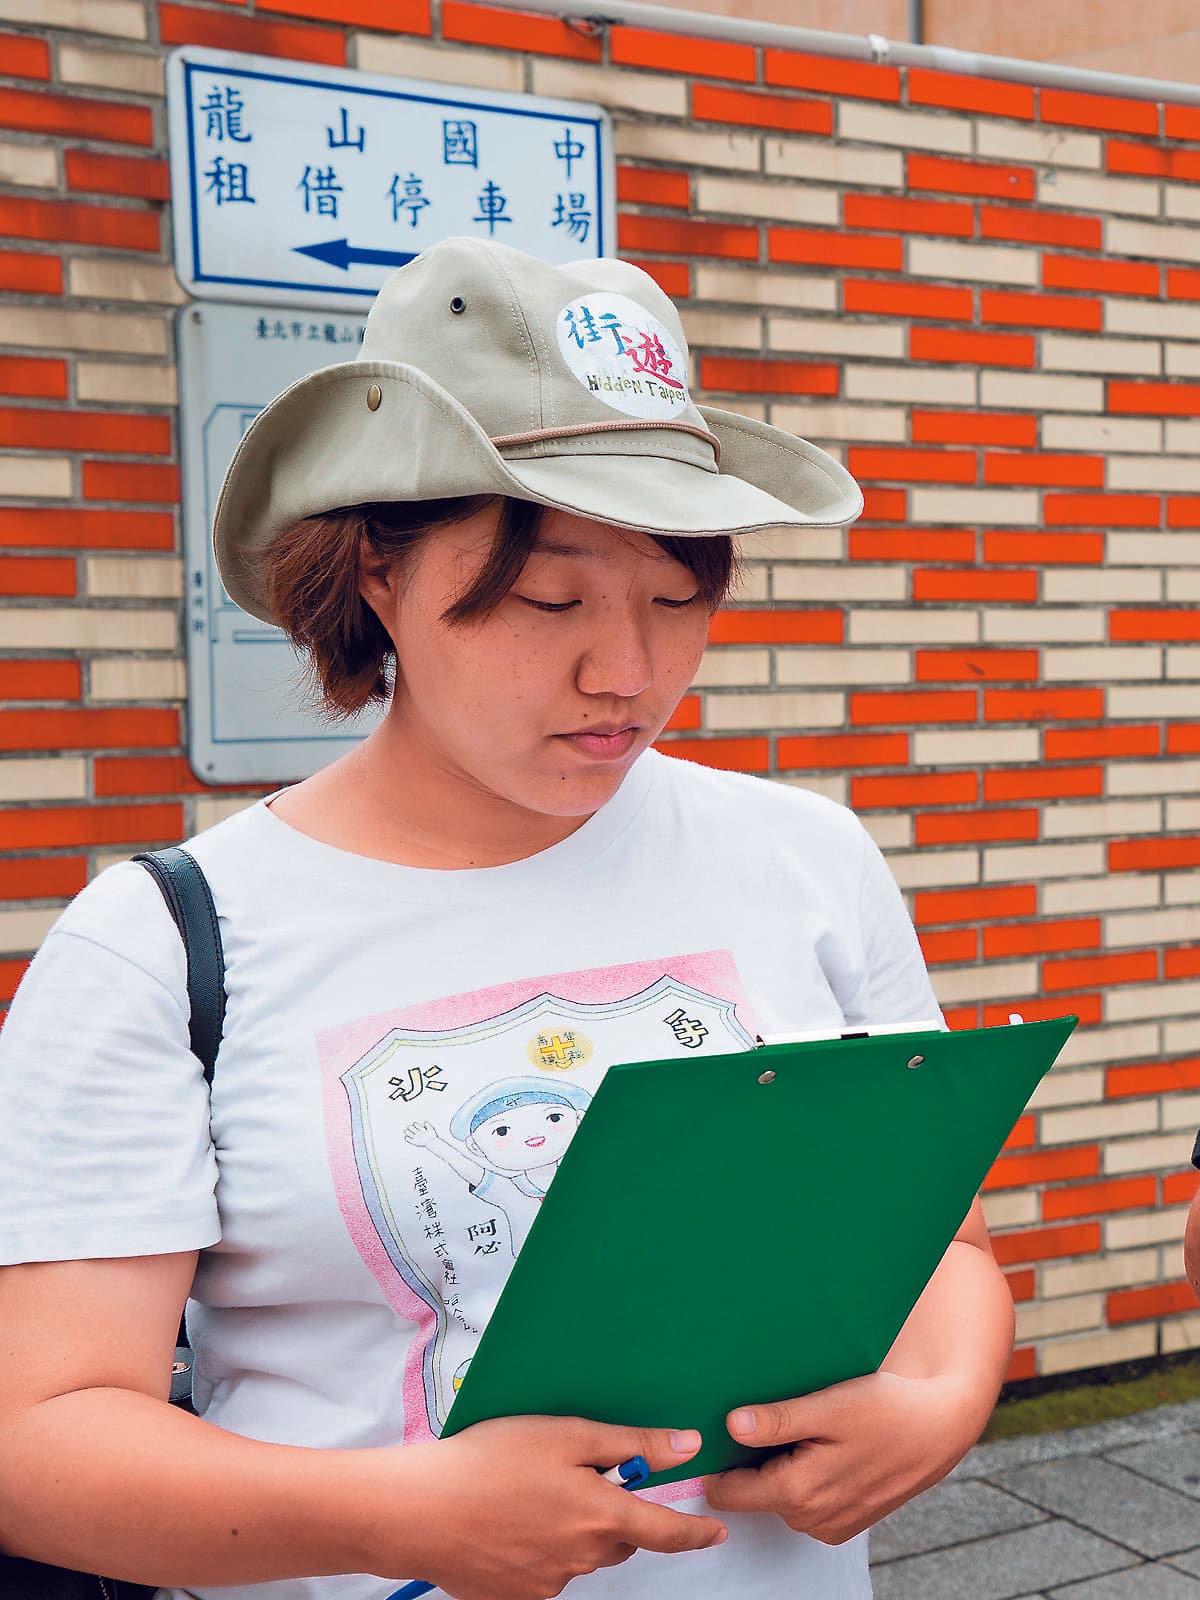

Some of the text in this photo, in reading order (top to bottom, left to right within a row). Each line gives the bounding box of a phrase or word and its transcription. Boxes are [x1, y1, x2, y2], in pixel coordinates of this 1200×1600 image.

[200, 85, 585, 180] 龍山國中
[203, 155, 592, 244] 租借停車場
